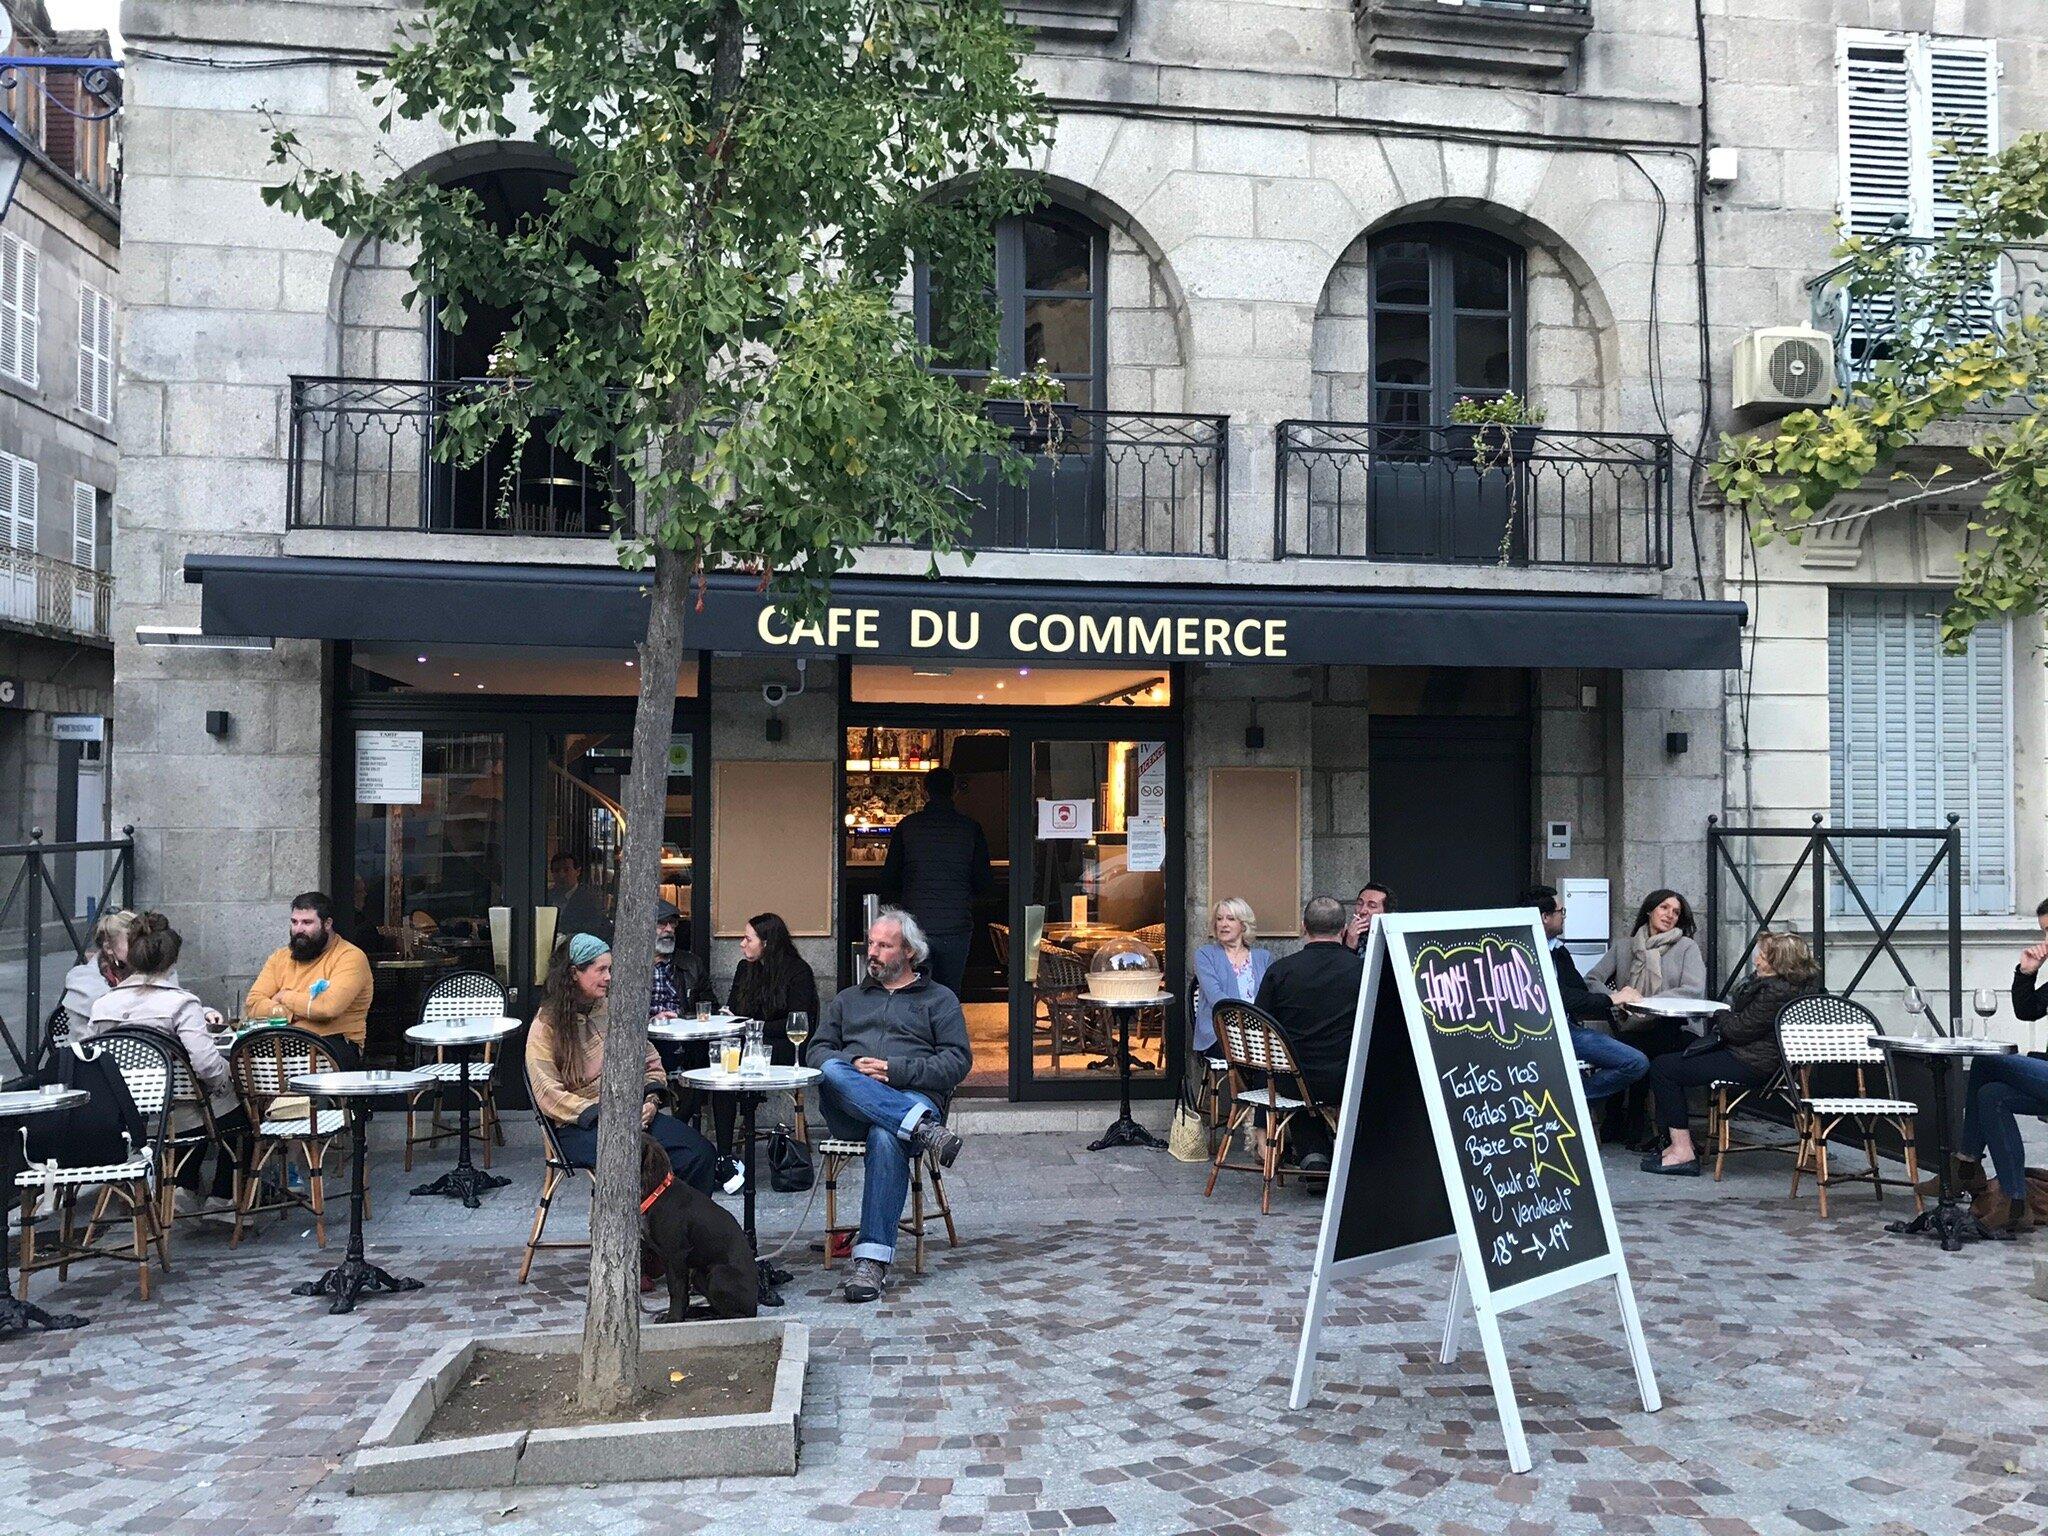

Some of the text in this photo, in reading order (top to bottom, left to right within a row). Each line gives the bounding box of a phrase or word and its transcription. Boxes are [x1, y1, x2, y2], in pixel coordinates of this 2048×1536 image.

[757, 604, 1288, 658] CAFE DU COMMERCE
[1442, 1061, 1539, 1099] Toutes nos
[1508, 1096, 1537, 1119] De
[1465, 1135, 1511, 1166] Bière
[1483, 1163, 1524, 1224] jeudi
